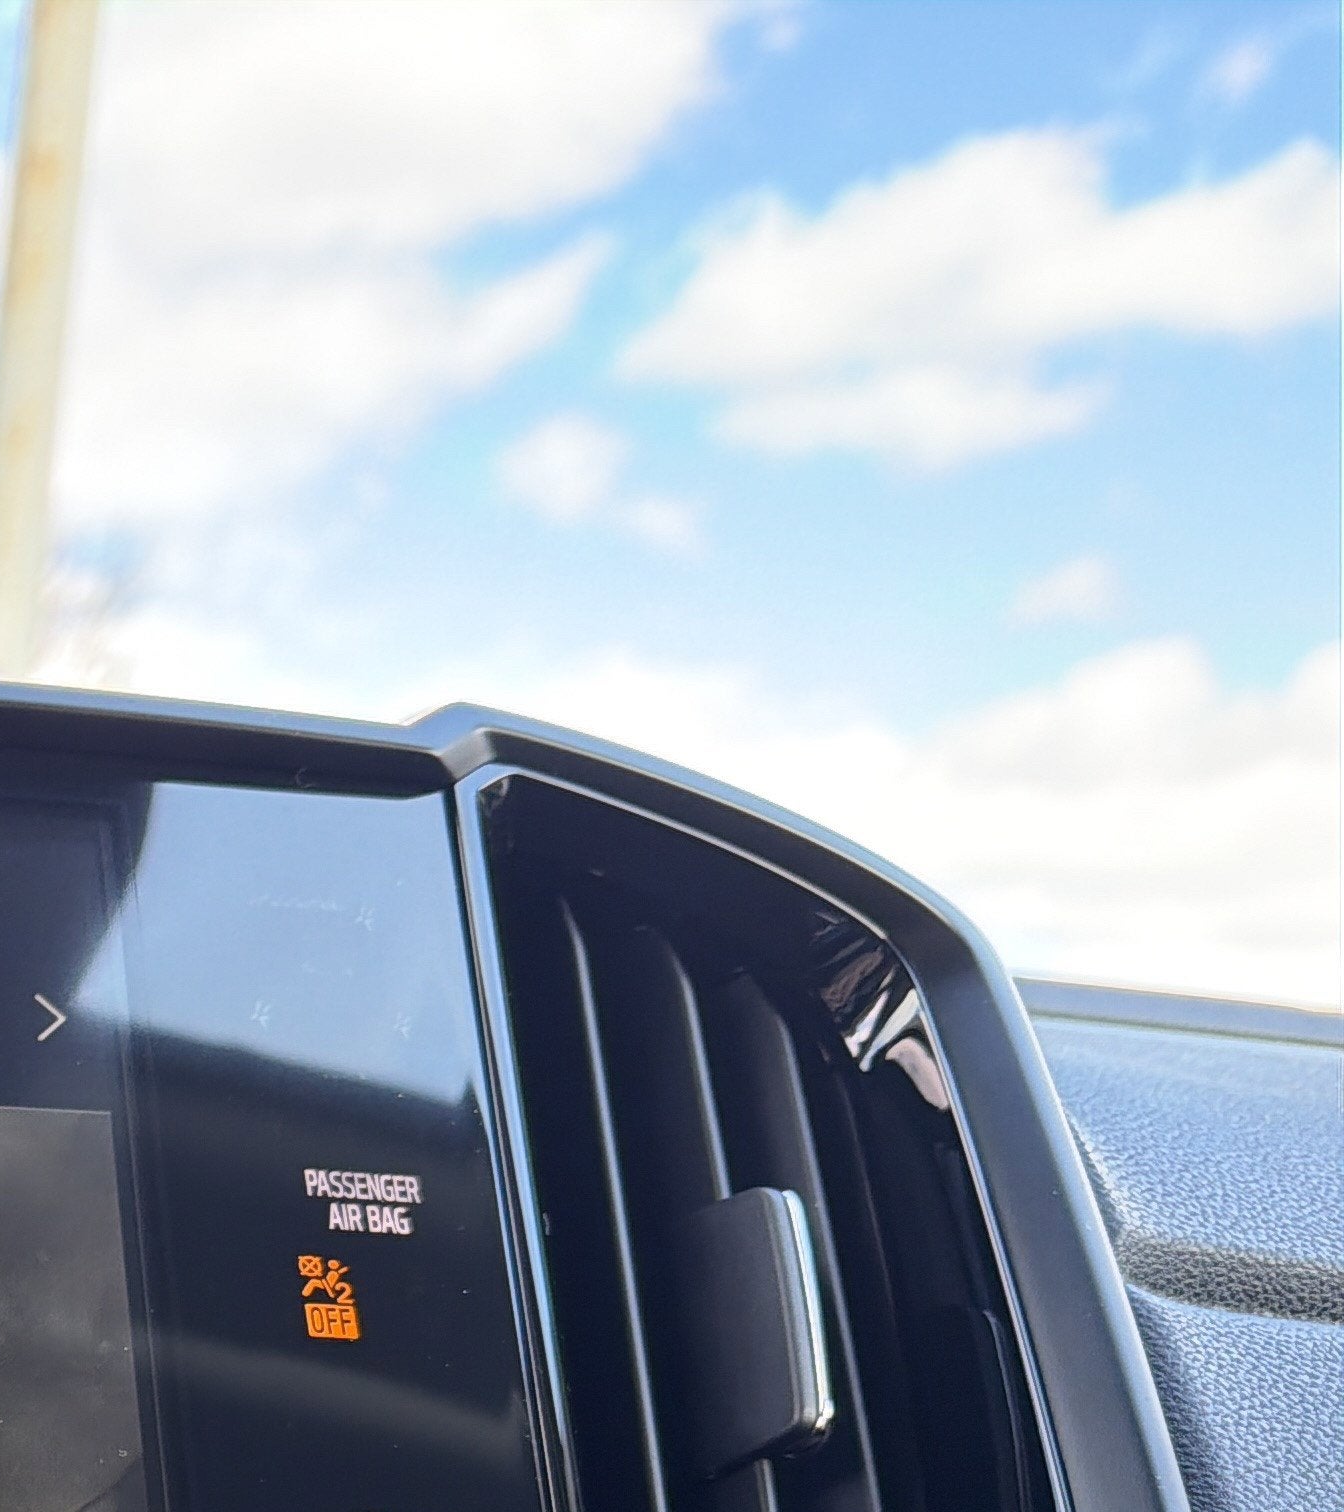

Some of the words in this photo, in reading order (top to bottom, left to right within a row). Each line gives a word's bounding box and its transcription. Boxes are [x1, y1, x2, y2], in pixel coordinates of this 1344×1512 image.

[303, 1168, 422, 1204] PASSENGER
[329, 1202, 363, 1231] AIR
[366, 1205, 412, 1235] BAG
[311, 1306, 352, 1335] OFF
